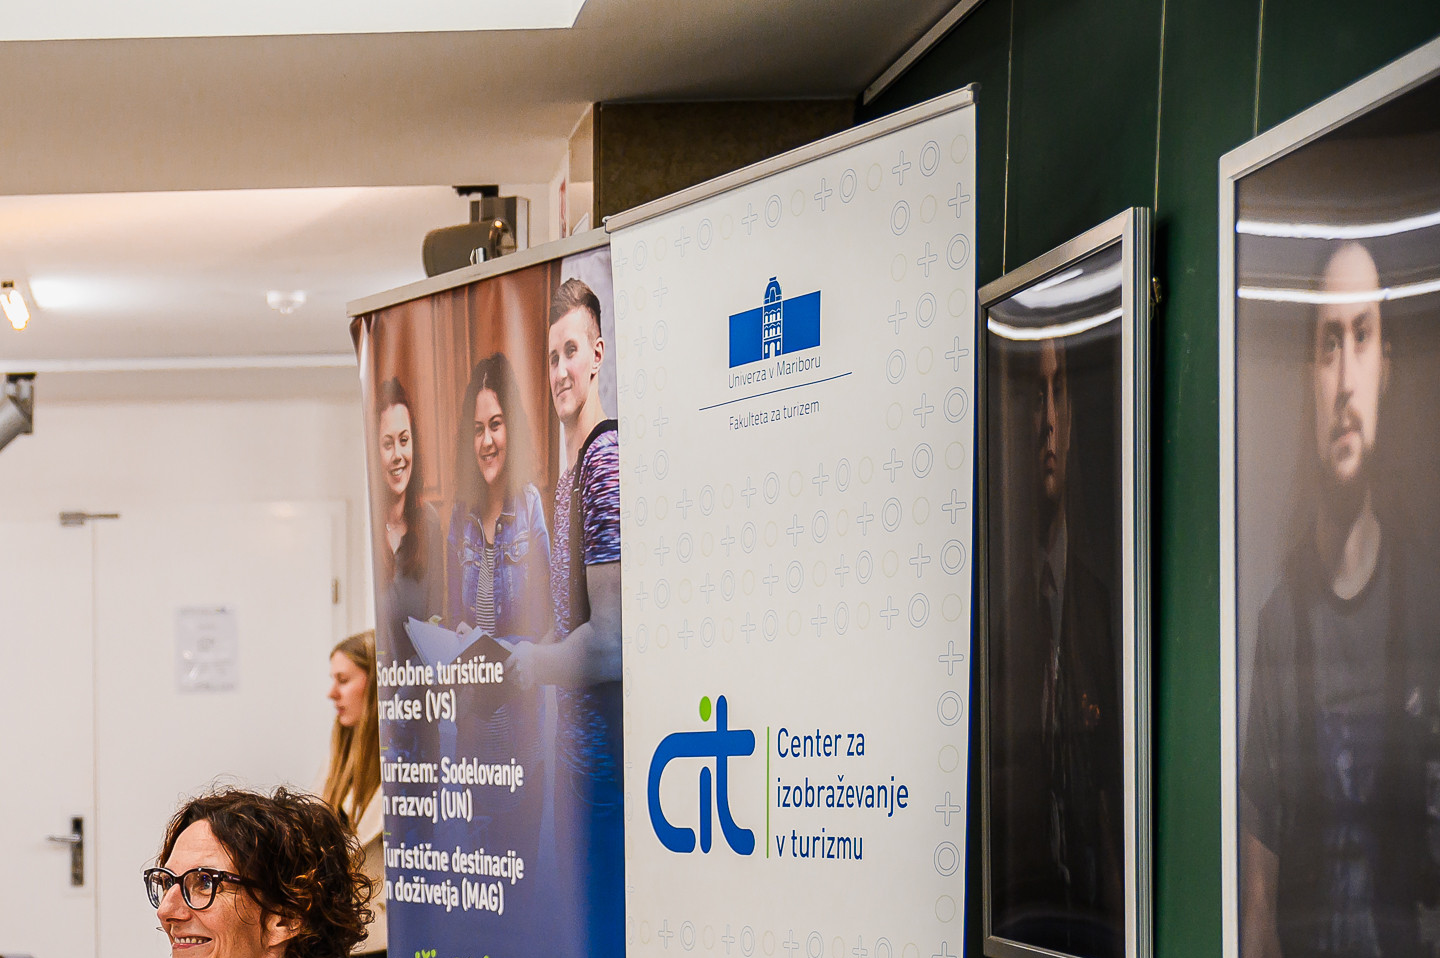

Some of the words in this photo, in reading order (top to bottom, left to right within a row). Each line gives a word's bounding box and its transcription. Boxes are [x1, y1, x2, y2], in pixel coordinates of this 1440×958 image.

[728, 370, 766, 389] Univerza
[768, 367, 775, 379] v
[776, 356, 821, 377] Mariboru
[729, 412, 768, 431] Fakulteta
[771, 409, 781, 422] za
[783, 400, 820, 420] turizem
[377, 660, 433, 687] Sodobne
[436, 655, 504, 685] turistične
[426, 688, 456, 723] (VS)
[776, 727, 842, 759] Center
[847, 731, 866, 757] za
[441, 756, 524, 793] Sodelovanje
[392, 790, 438, 824] razvoj
[441, 787, 473, 822] (UN)
[776, 775, 909, 818] izobraževanje
[776, 834, 786, 858] v
[791, 827, 864, 860] turizmu
[452, 846, 524, 885] destinacije
[395, 875, 459, 912] doživetja
[462, 877, 504, 916] (MAG)
